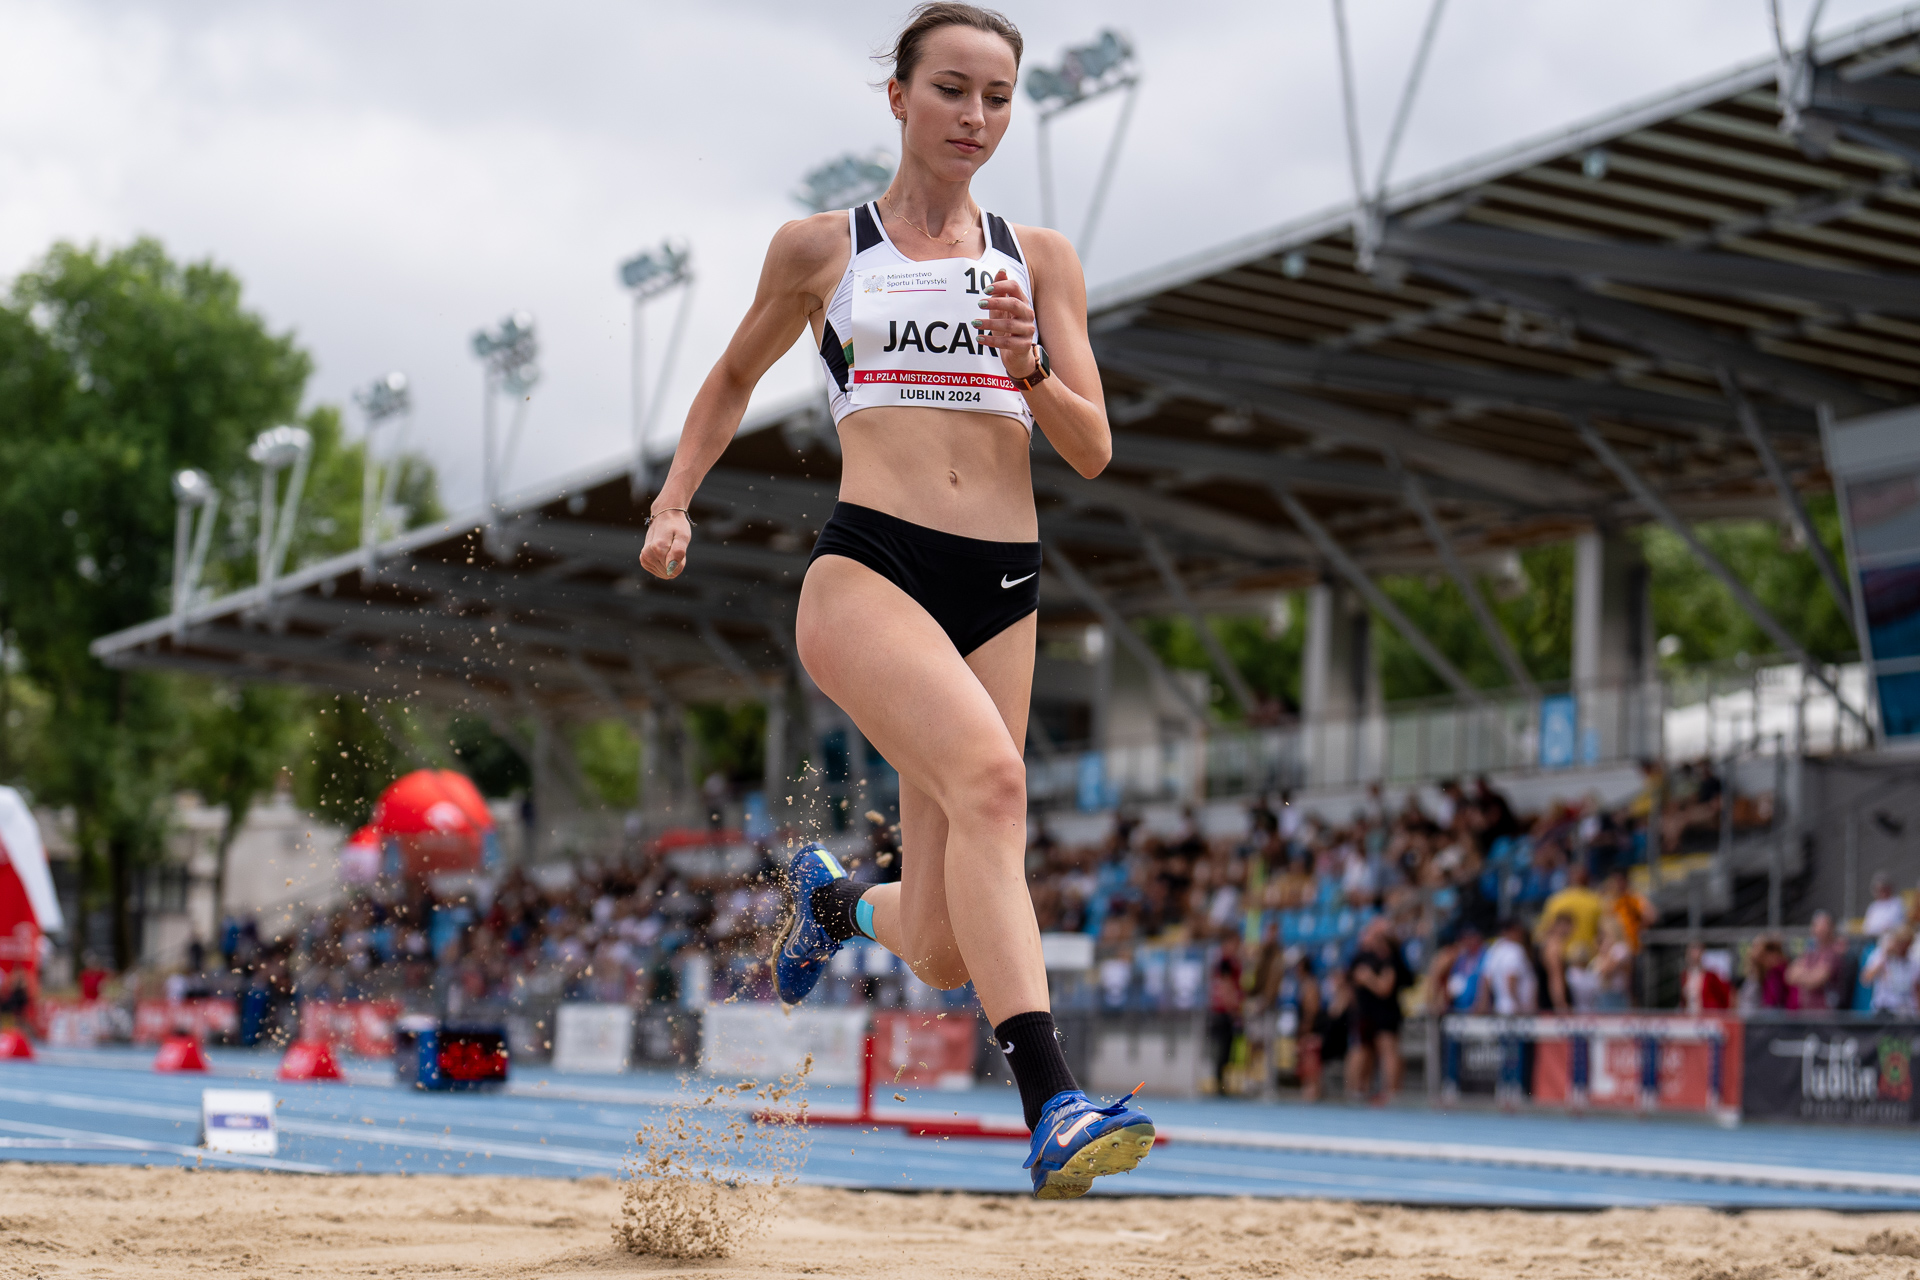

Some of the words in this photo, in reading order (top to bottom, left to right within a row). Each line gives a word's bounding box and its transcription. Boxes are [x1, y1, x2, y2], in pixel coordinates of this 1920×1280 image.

[886, 280, 910, 288] Sportu
[915, 277, 947, 286] Turystyki
[887, 272, 933, 280] Ministerstwo
[863, 373, 875, 382] 41.
[876, 372, 897, 382] PZLA
[900, 373, 968, 384] MISTRZOSTWA
[970, 376, 999, 387] POLSKI
[900, 389, 945, 401] LUBLIN
[948, 390, 981, 403] 2024
[1050, 1101, 1090, 1128] NIKE
